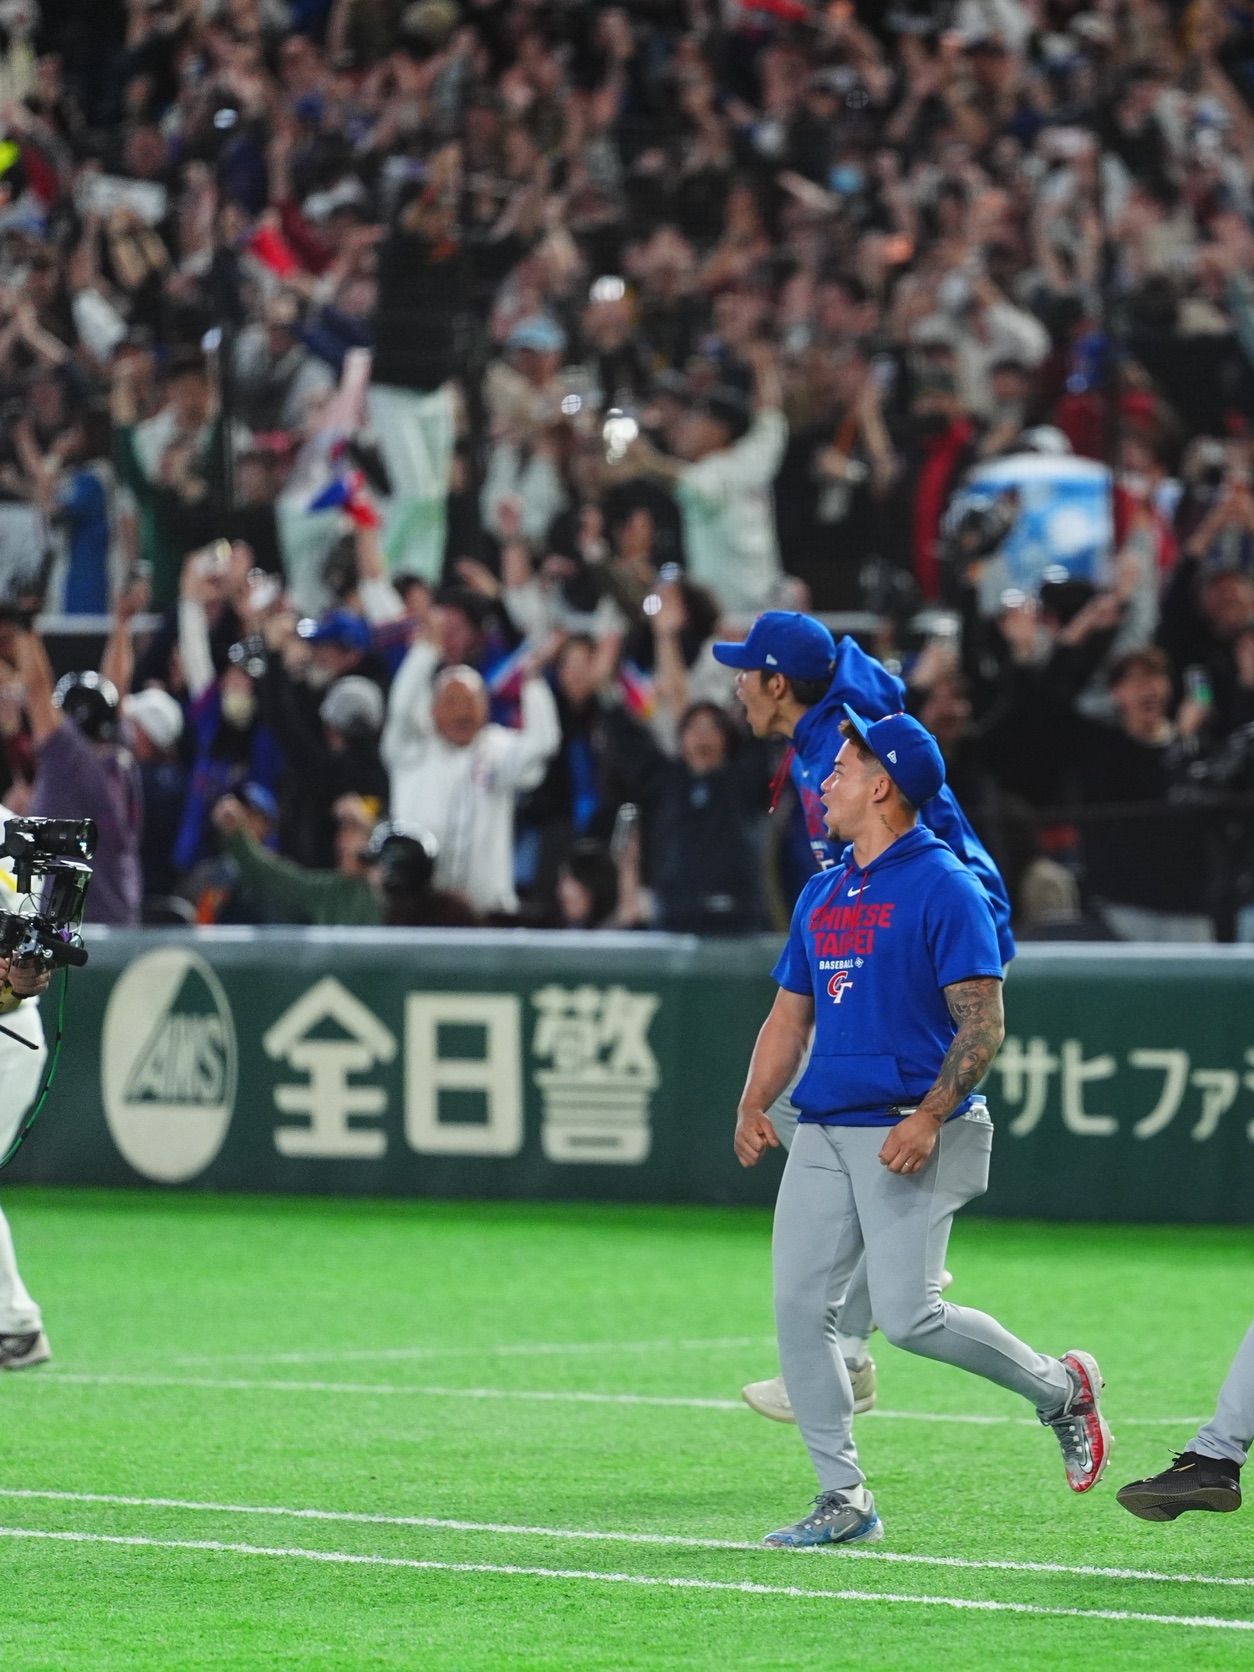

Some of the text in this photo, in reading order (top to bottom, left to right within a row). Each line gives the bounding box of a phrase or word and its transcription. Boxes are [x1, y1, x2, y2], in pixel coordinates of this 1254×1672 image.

[808, 902, 895, 931] CHINESE
[814, 929, 875, 958] TAIPEI
[818, 958, 854, 970] BASEBALL
[262, 975, 660, 1165] 全日警
